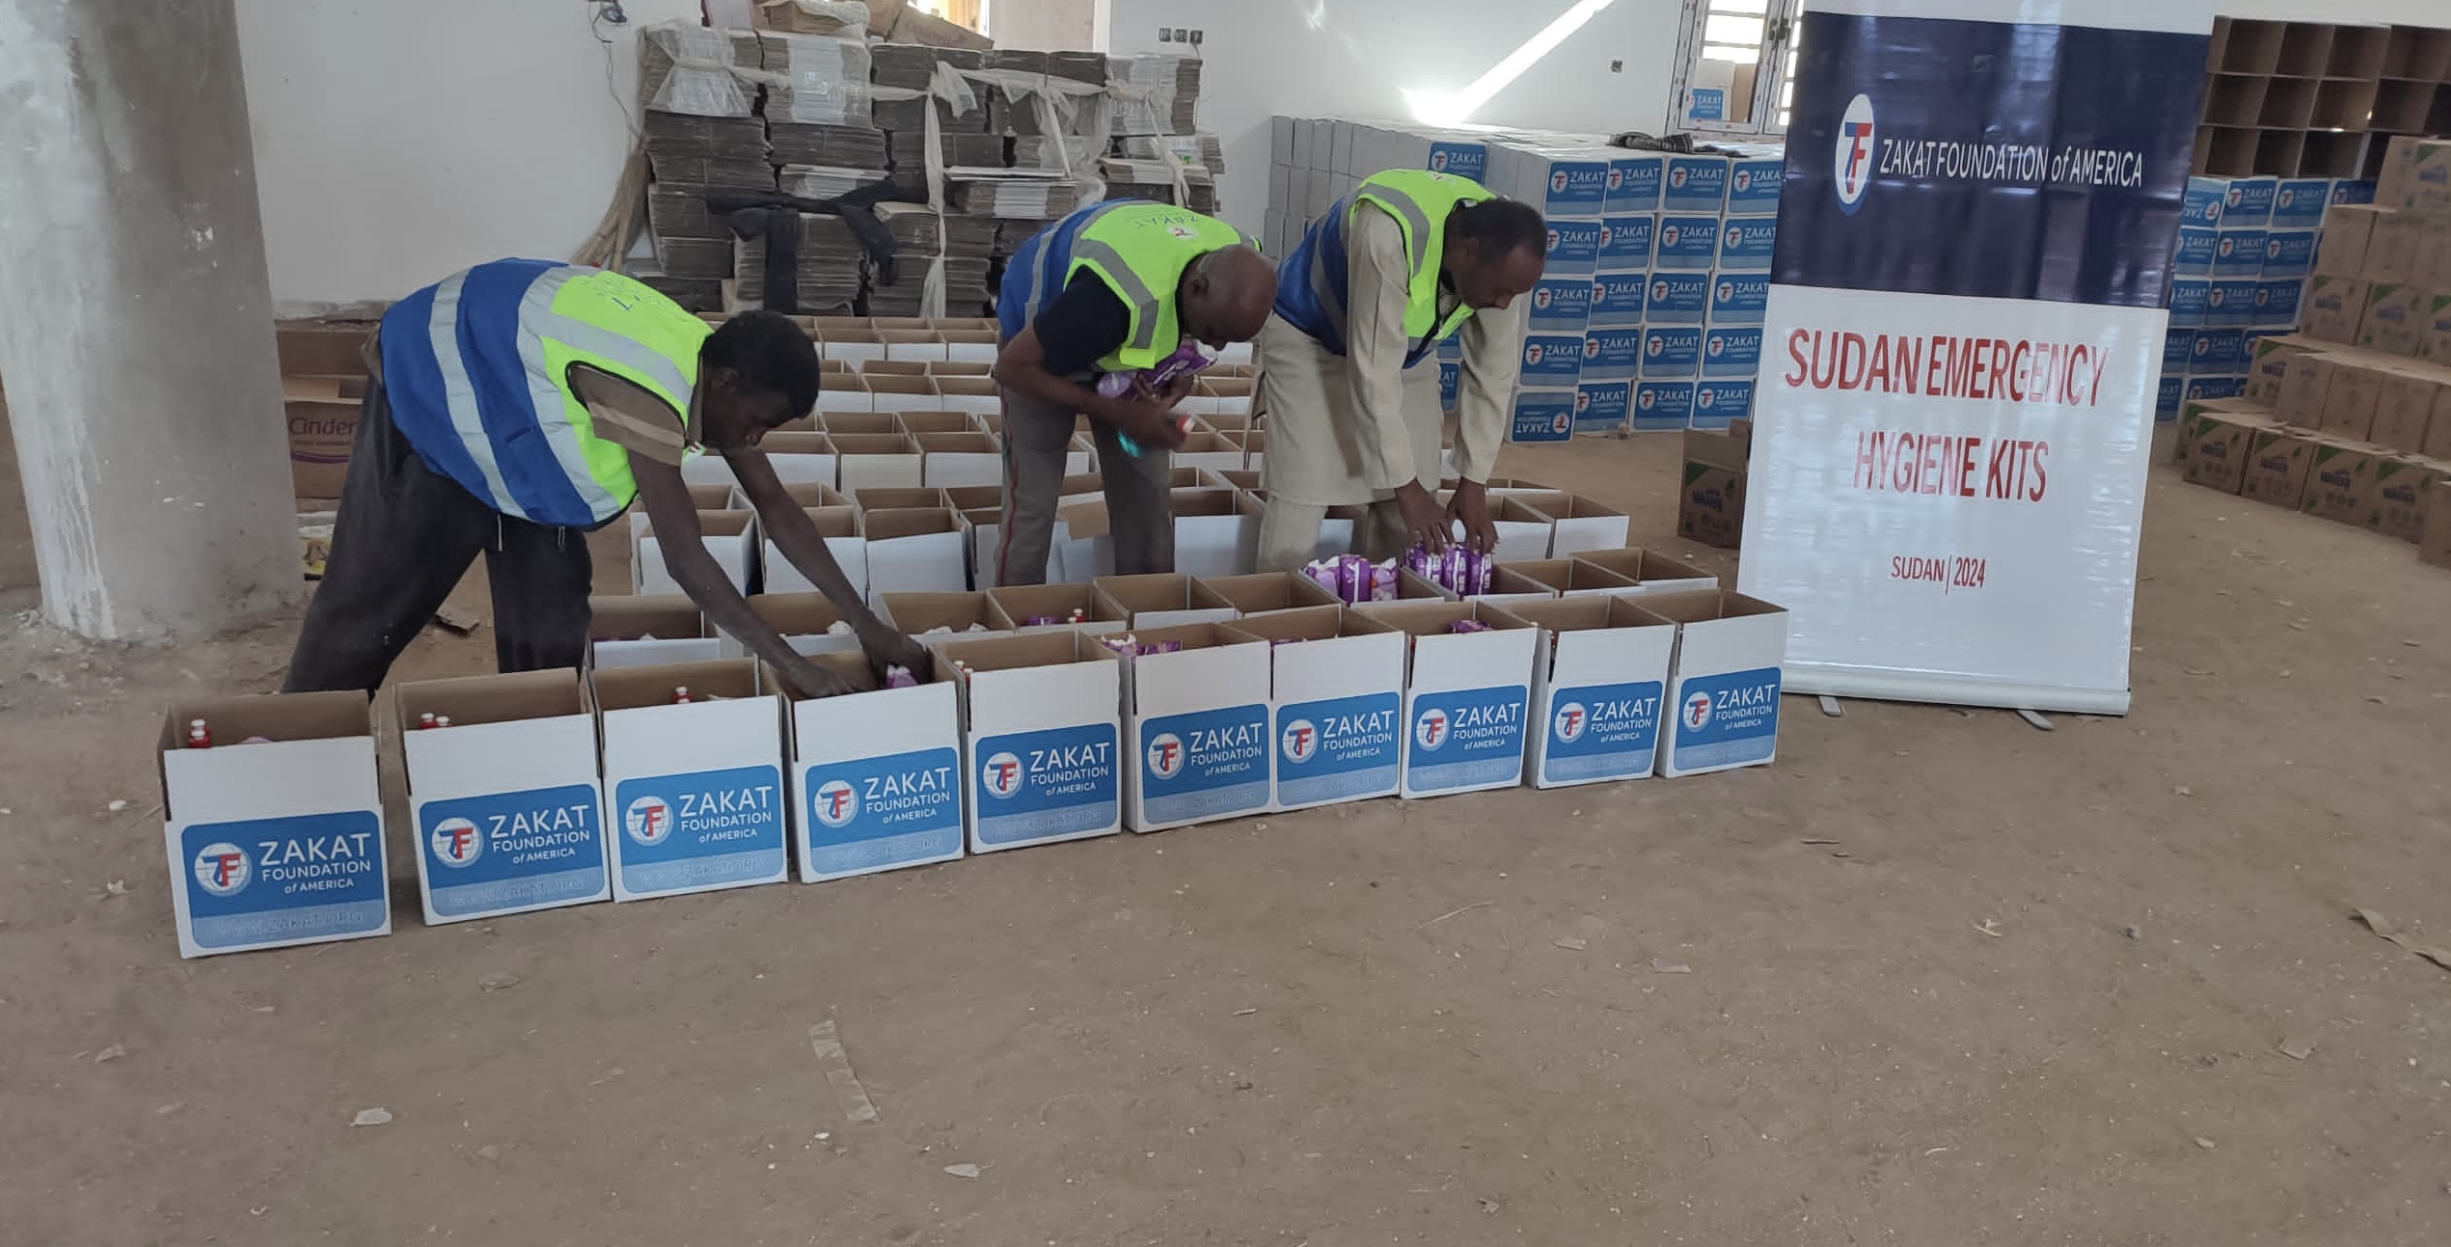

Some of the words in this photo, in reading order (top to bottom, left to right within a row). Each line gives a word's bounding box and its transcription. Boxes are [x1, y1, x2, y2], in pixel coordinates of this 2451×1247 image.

[1450, 152, 1484, 165] ZAKAT
[1880, 139, 1940, 177] ZAKAT
[1936, 142, 2048, 181] FOUNDATION
[2051, 145, 2071, 182] of
[2069, 148, 2143, 188] AMERICA
[1570, 171, 1605, 183] ZAKAT
[1625, 168, 1660, 180] ZAKAT
[1689, 168, 1724, 179] ZAKAT
[1753, 170, 1780, 181] ZAKA
[2243, 188, 2273, 199] ZAKAT
[1563, 231, 1598, 241] ZAKAT
[1615, 226, 1650, 238] ZAKAT
[1681, 227, 1715, 237] ZAKAT
[2186, 237, 2215, 247] ZAKAT
[2235, 238, 2264, 248] ZAKAT
[1554, 288, 1590, 300] ZAKAT
[1608, 283, 1643, 294] ZAKAT
[1670, 282, 1705, 293] ZAKAT
[2178, 287, 2207, 297] ZAKAT
[1602, 338, 1637, 349] ZAKAT
[1665, 336, 1699, 347] ZAKAT
[1727, 336, 1759, 347] ZAKAT
[1545, 345, 1580, 355] ZAKAT
[1785, 328, 1922, 395] SUDAN
[1926, 335, 2109, 406] EMERGENCY
[1592, 390, 1627, 402] ZAKAT
[1657, 390, 1691, 400] ZAKAT
[1716, 389, 1749, 400] ZAKAT
[1515, 423, 1551, 433] ZAKAT
[1853, 430, 1981, 497] HYGIENE
[1985, 438, 2049, 502] KITS
[1891, 555, 1945, 582] SUDAN
[1953, 557, 1986, 588] 2024
[1716, 684, 1776, 710] ZAKAT
[1454, 703, 1521, 727] ZAKAT
[1592, 698, 1656, 721] ZAKAT
[1716, 704, 1772, 721] FOUNDATION
[1323, 709, 1394, 738] ZAKAT
[1591, 718, 1652, 733] FOUNDATION
[1190, 723, 1263, 753] ZAKAT
[1454, 724, 1517, 740] FOUNDATION
[1324, 732, 1392, 750] FOUNDATION
[1464, 741, 1472, 750] of
[1473, 739, 1505, 749] AMERICA
[1030, 742, 1110, 773] ZAKAT
[1191, 746, 1262, 766] FOUNDATION
[1336, 752, 1345, 761] of
[1346, 747, 1380, 759] AMERICA
[1031, 766, 1109, 786] FOUNDATION
[1205, 768, 1213, 776] of
[1214, 762, 1251, 774] AMERICA
[864, 767, 951, 800] ZAKAT
[1046, 787, 1056, 796] of
[1057, 782, 1096, 794] AMERICA
[678, 786, 773, 818] ZAKAT
[866, 791, 950, 814] FOUNDATION
[488, 804, 589, 839] ZAKAT
[681, 812, 772, 832] FOUNDATION
[883, 814, 893, 824] of
[895, 808, 937, 822] AMERICA
[493, 830, 590, 853] FOUNDATION
[699, 833, 710, 844] of
[712, 828, 758, 842] AMERICA
[258, 833, 371, 867] ZAKAT
[512, 853, 524, 864] of
[526, 848, 576, 863] AMERICA
[262, 860, 371, 882] FOUNDATION
[284, 882, 298, 894] of
[299, 879, 354, 892] AMERICA
